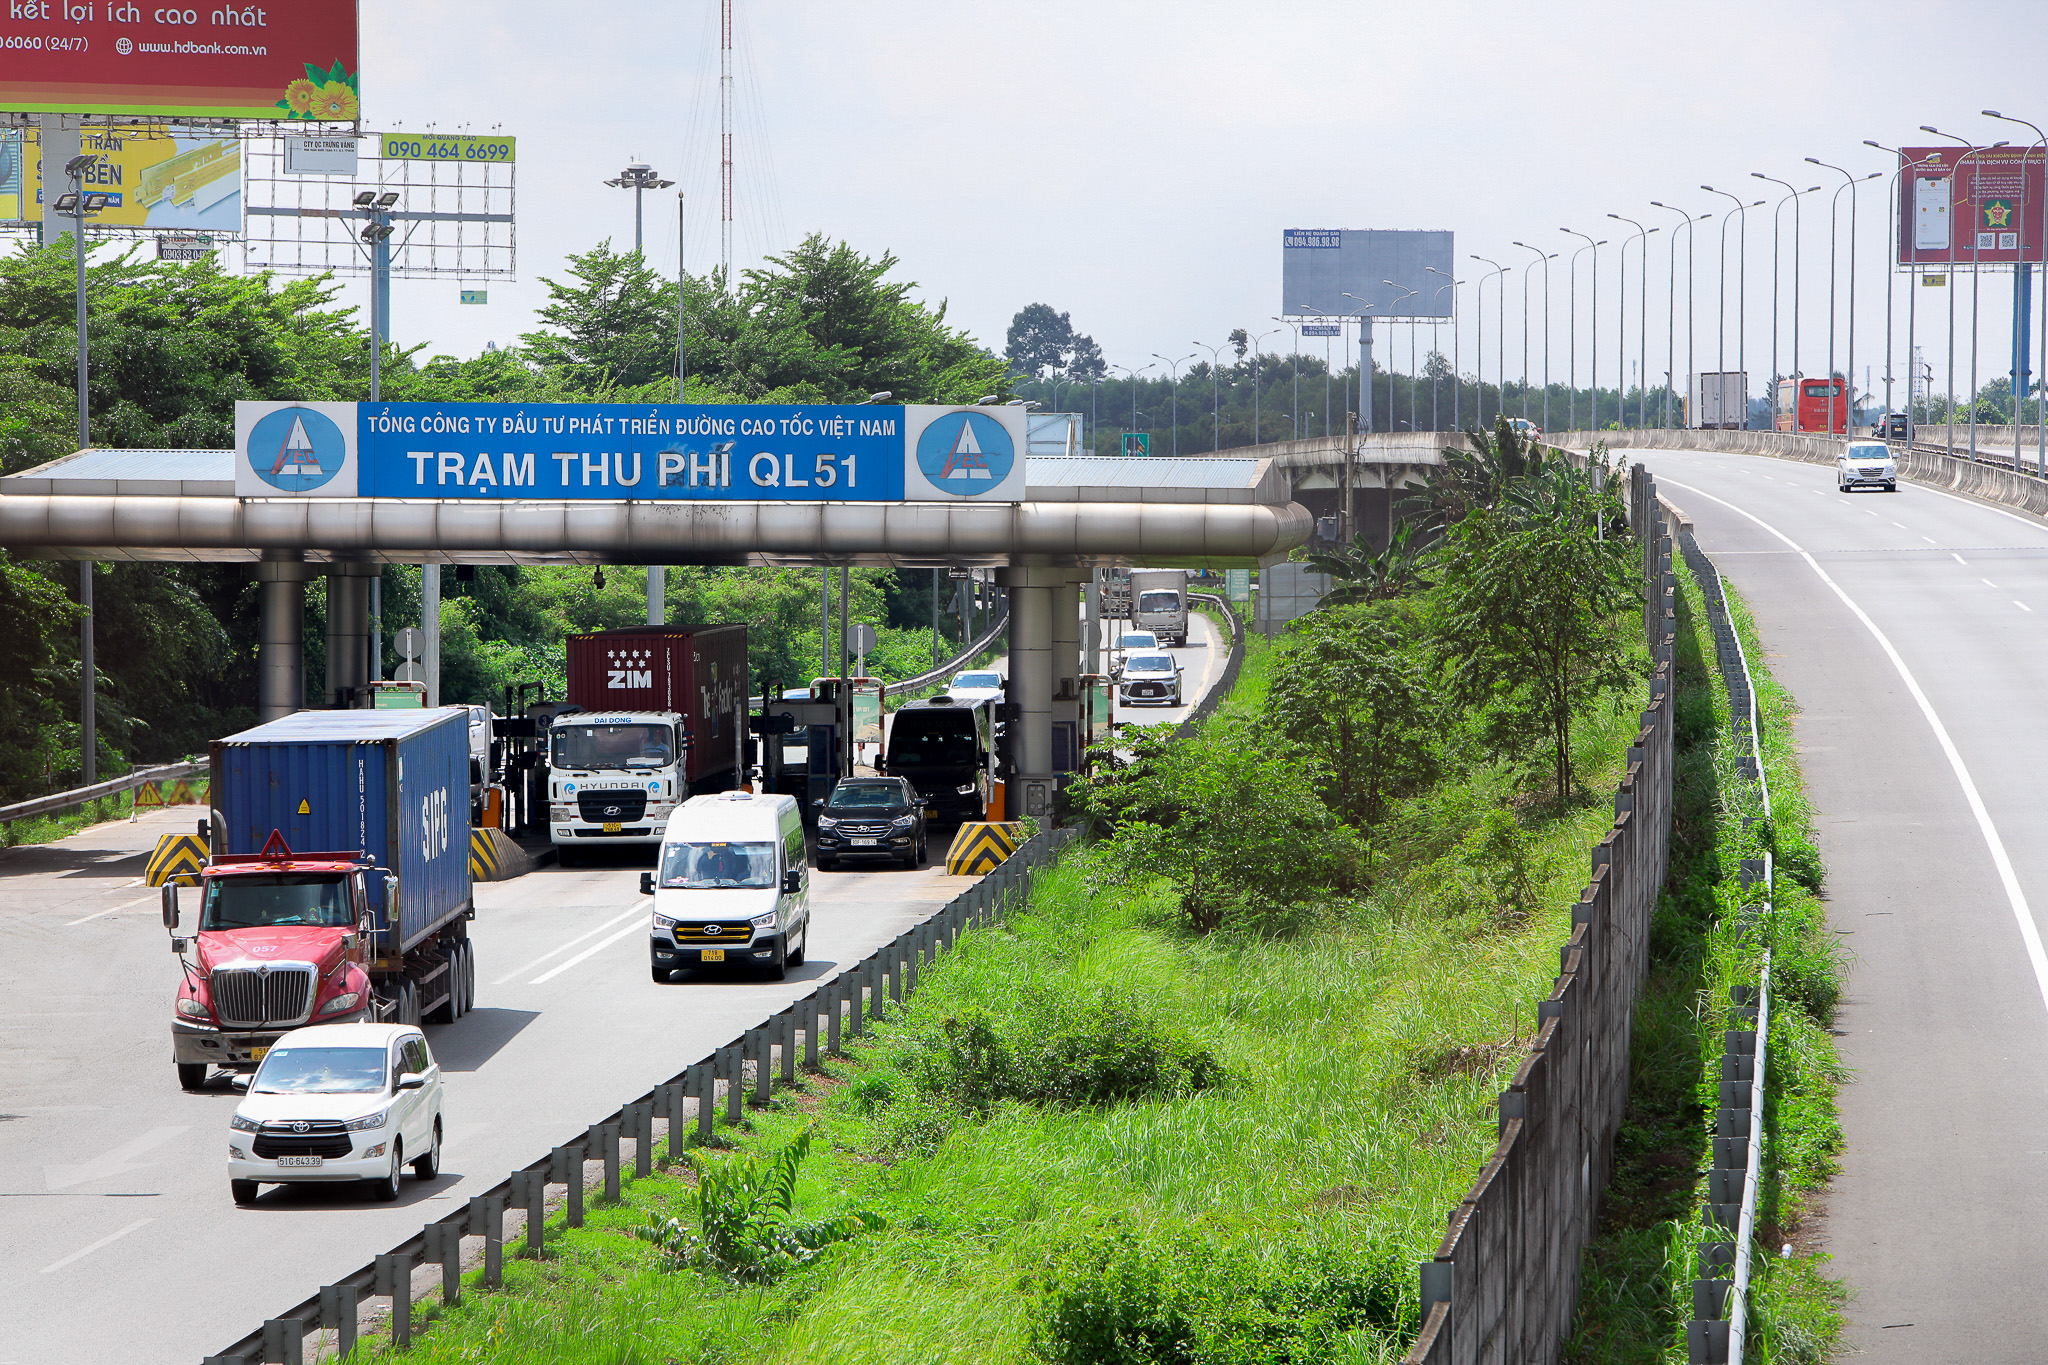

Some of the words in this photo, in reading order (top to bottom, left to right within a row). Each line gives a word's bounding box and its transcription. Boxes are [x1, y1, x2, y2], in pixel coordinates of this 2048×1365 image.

[63, 0, 93, 25] lợi
[107, 2, 140, 24] ích
[154, 8, 198, 25] cao
[211, 4, 267, 27] nhất
[44, 36, 89, 52] (24/7)
[138, 40, 267, 56] www.hdbank.com.vn
[303, 140, 313, 148] CTY
[388, 141, 421, 158] 090
[426, 143, 460, 158] 464
[465, 144, 509, 160] 6699
[1293, 236, 1340, 247] 094.986.98.98
[368, 407, 415, 433] TỔNG
[421, 412, 469, 434] CÔNG
[475, 417, 497, 434] TY
[502, 410, 536, 434] ĐẦU
[542, 415, 565, 434] TƯ
[570, 413, 614, 434] PHÁT
[619, 408, 670, 435] TRIỂN
[676, 413, 735, 436] ĐƯỜNG
[741, 418, 776, 436] CAO
[780, 411, 814, 436] TỐC
[819, 414, 854, 440] VIỆT
[860, 419, 896, 436] NAM
[407, 452, 535, 493] TRẠM
[552, 453, 641, 487] THU
[659, 443, 734, 487] PHÍ
[749, 453, 856, 488] QL51
[607, 670, 652, 688] ZIM
[422, 786, 448, 863] SIPG
[252, 945, 278, 953] 057
